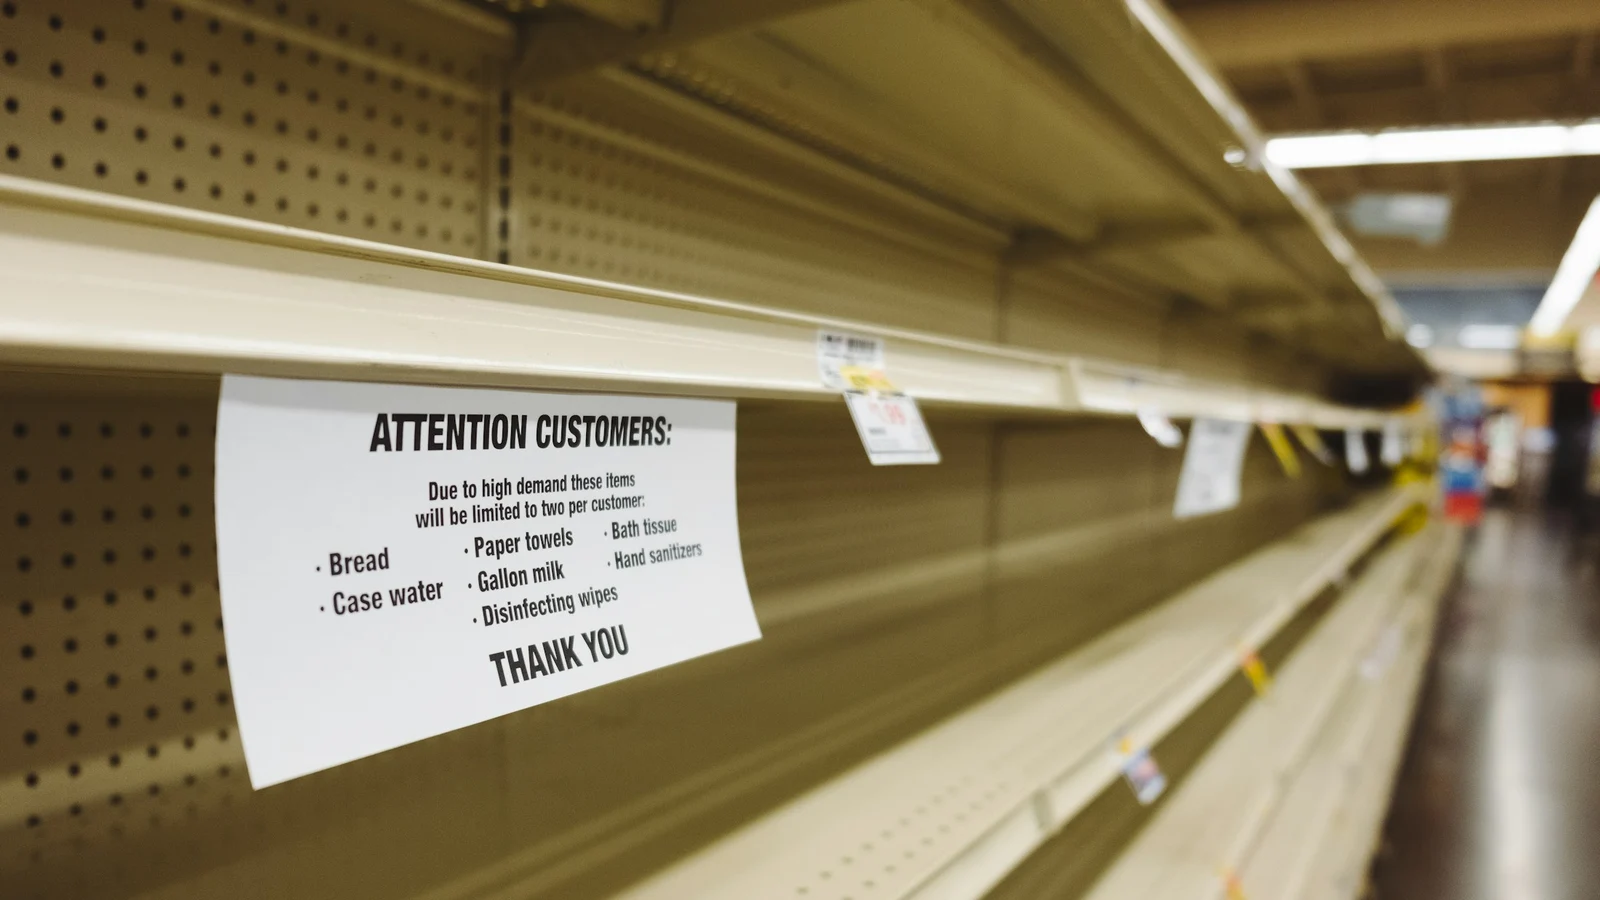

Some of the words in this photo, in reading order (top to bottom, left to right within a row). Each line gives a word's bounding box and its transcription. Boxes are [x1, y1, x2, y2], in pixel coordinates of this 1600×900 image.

[369, 413, 528, 453] ATTENTION
[536, 414, 673, 452] CUSTOMERS:
[429, 482, 458, 502] Due
[462, 480, 477, 500] to
[481, 478, 513, 502] high
[516, 475, 568, 498] demand
[570, 473, 603, 493] these
[605, 472, 636, 490] items
[415, 508, 445, 529] will
[449, 506, 469, 527] be
[471, 500, 521, 525] limited
[524, 501, 538, 520] to
[540, 499, 566, 519] two
[568, 500, 589, 521] per
[591, 495, 645, 514] customer:
[611, 519, 640, 541] Bath
[643, 517, 677, 537] tissue
[474, 536, 521, 562] Paper
[524, 527, 574, 553] towels
[614, 549, 646, 571] Hand
[648, 543, 703, 567] sanitizers
[328, 547, 390, 577] Bread
[478, 567, 529, 594] Gallon
[532, 560, 566, 585] milk
[333, 590, 384, 616] Case
[388, 580, 444, 608] water
[482, 594, 576, 627] Disinfecting
[577, 586, 619, 612] wipes
[489, 635, 584, 688] THANK
[581, 624, 630, 664] YOU
